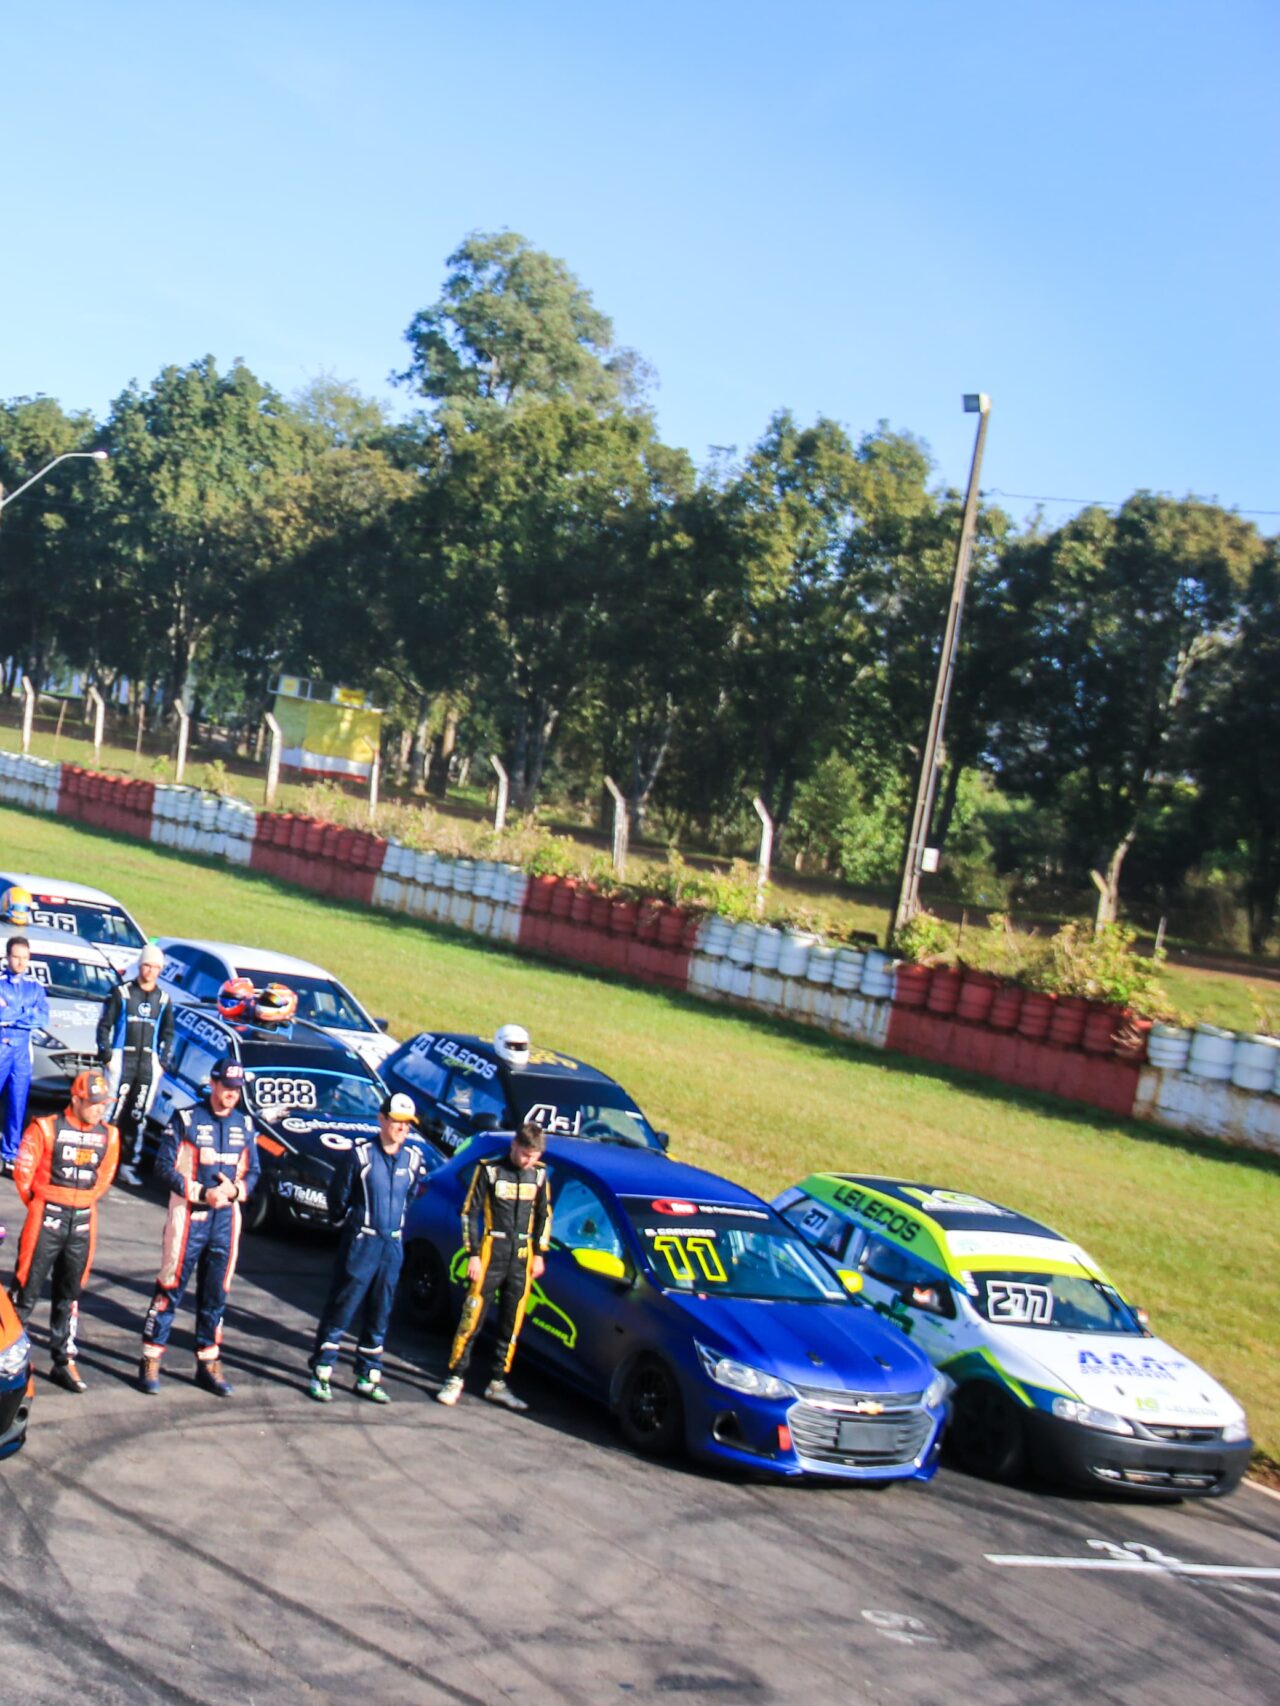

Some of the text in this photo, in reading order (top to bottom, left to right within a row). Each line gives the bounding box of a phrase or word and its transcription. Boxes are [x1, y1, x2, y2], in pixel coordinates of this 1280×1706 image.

[176, 1008, 232, 1051] LELECOS
[434, 1038, 498, 1080] LELECOS
[255, 1078, 317, 1108] 888
[834, 1184, 921, 1242] LELECOS
[654, 1236, 728, 1282] 11
[986, 1280, 1053, 1325] 277
